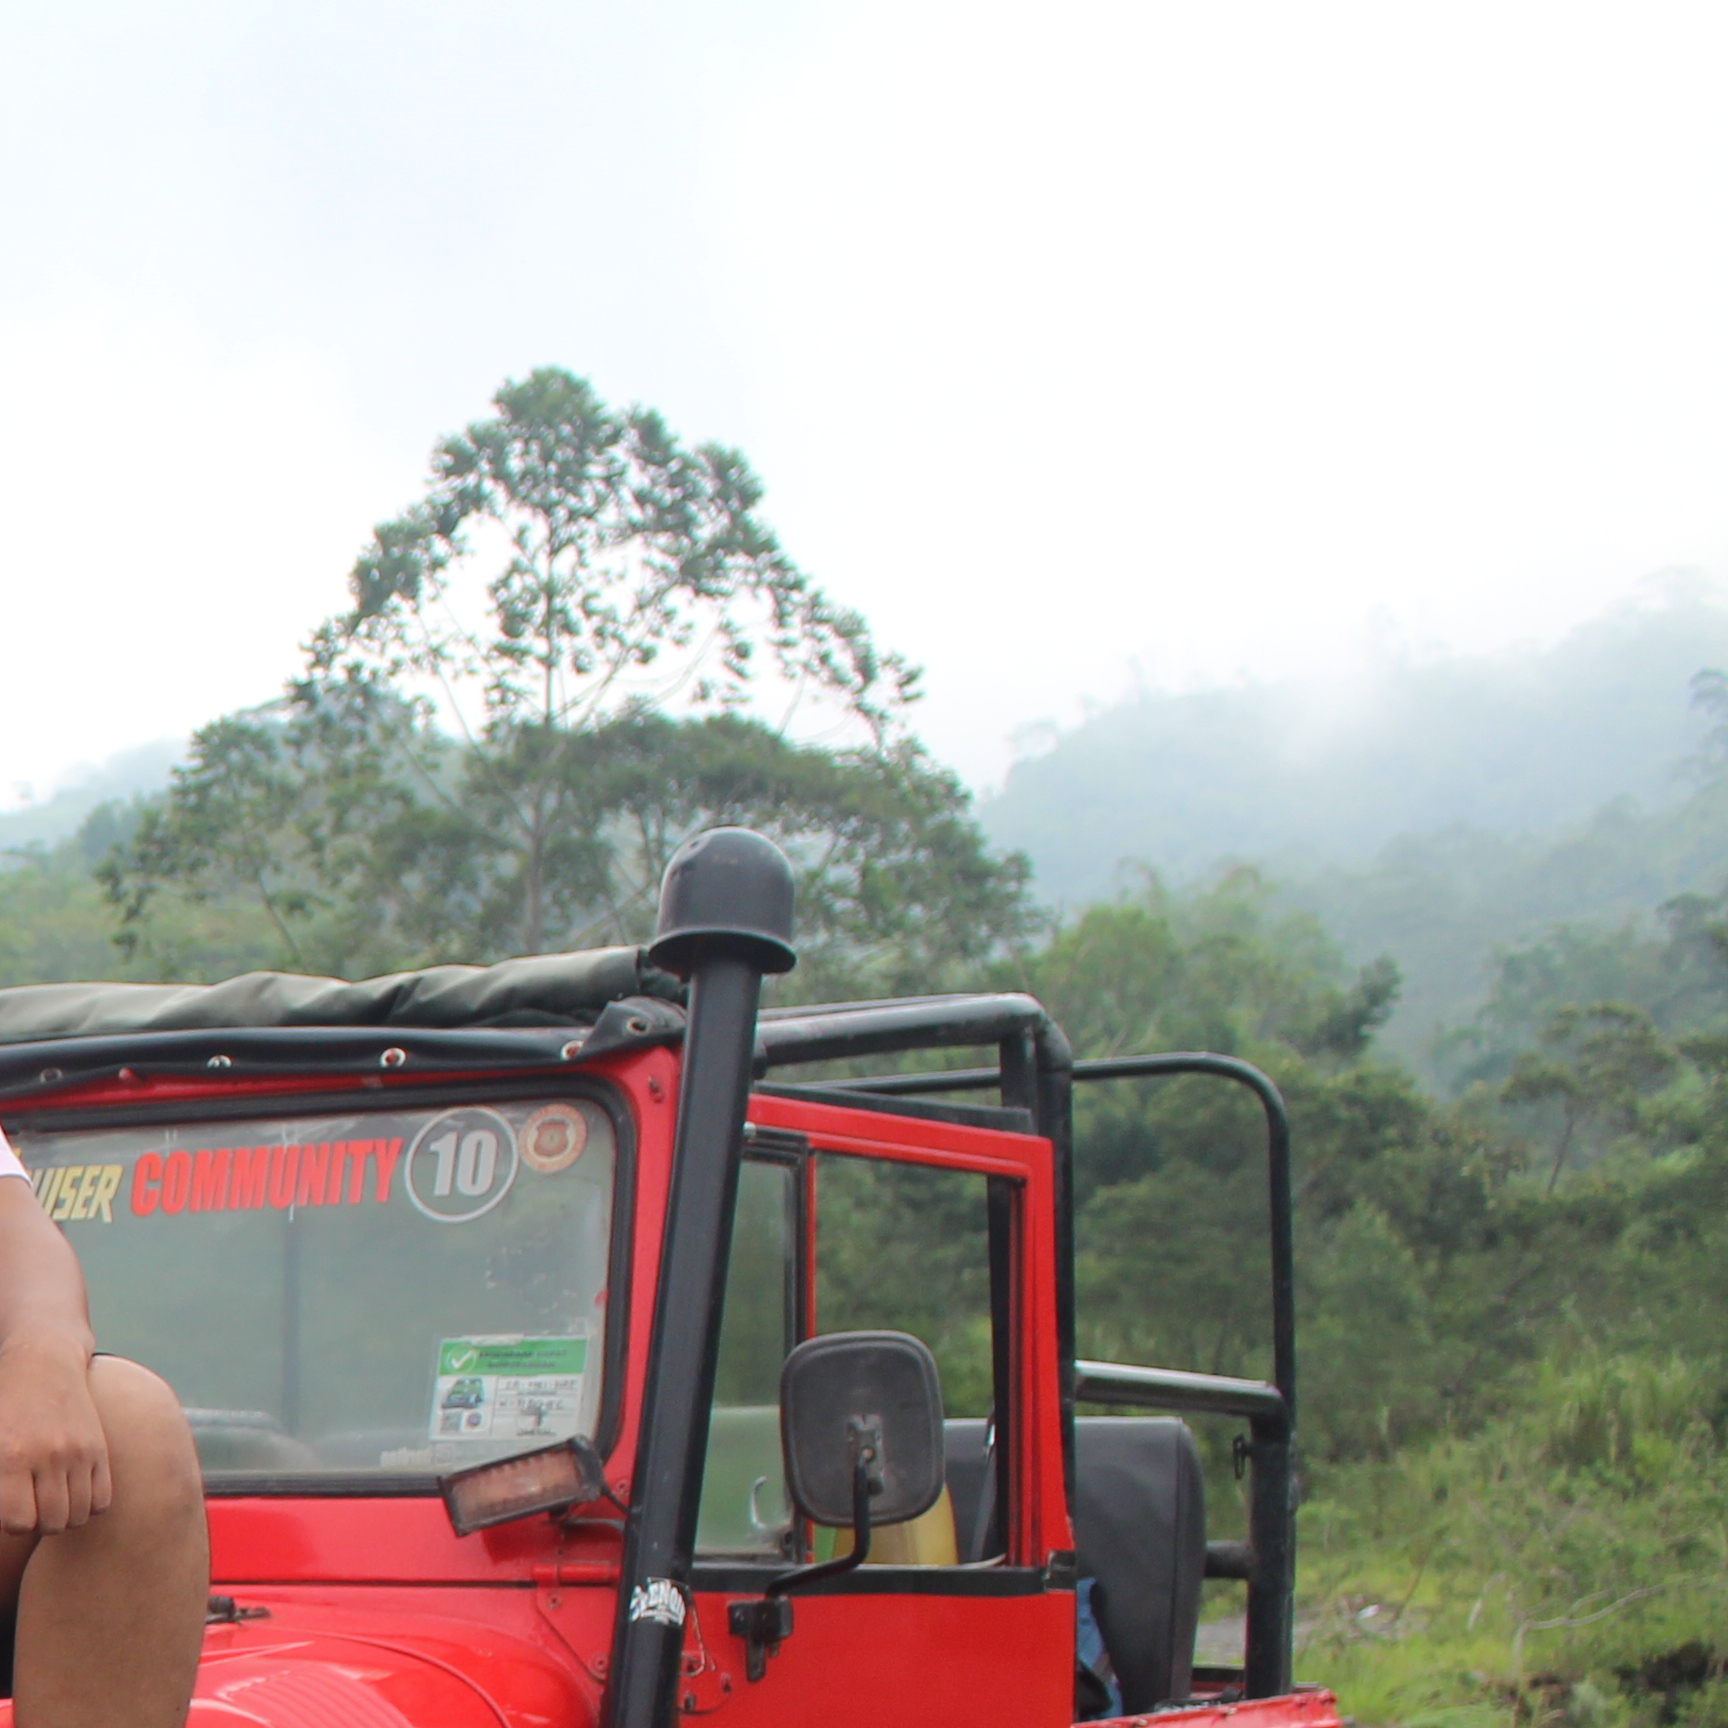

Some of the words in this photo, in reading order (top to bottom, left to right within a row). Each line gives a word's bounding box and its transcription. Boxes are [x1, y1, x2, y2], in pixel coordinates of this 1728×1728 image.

[26, 1163, 125, 1224] UISER
[130, 1136, 404, 1217] COMMUNITY
[429, 1128, 499, 1197] 10
